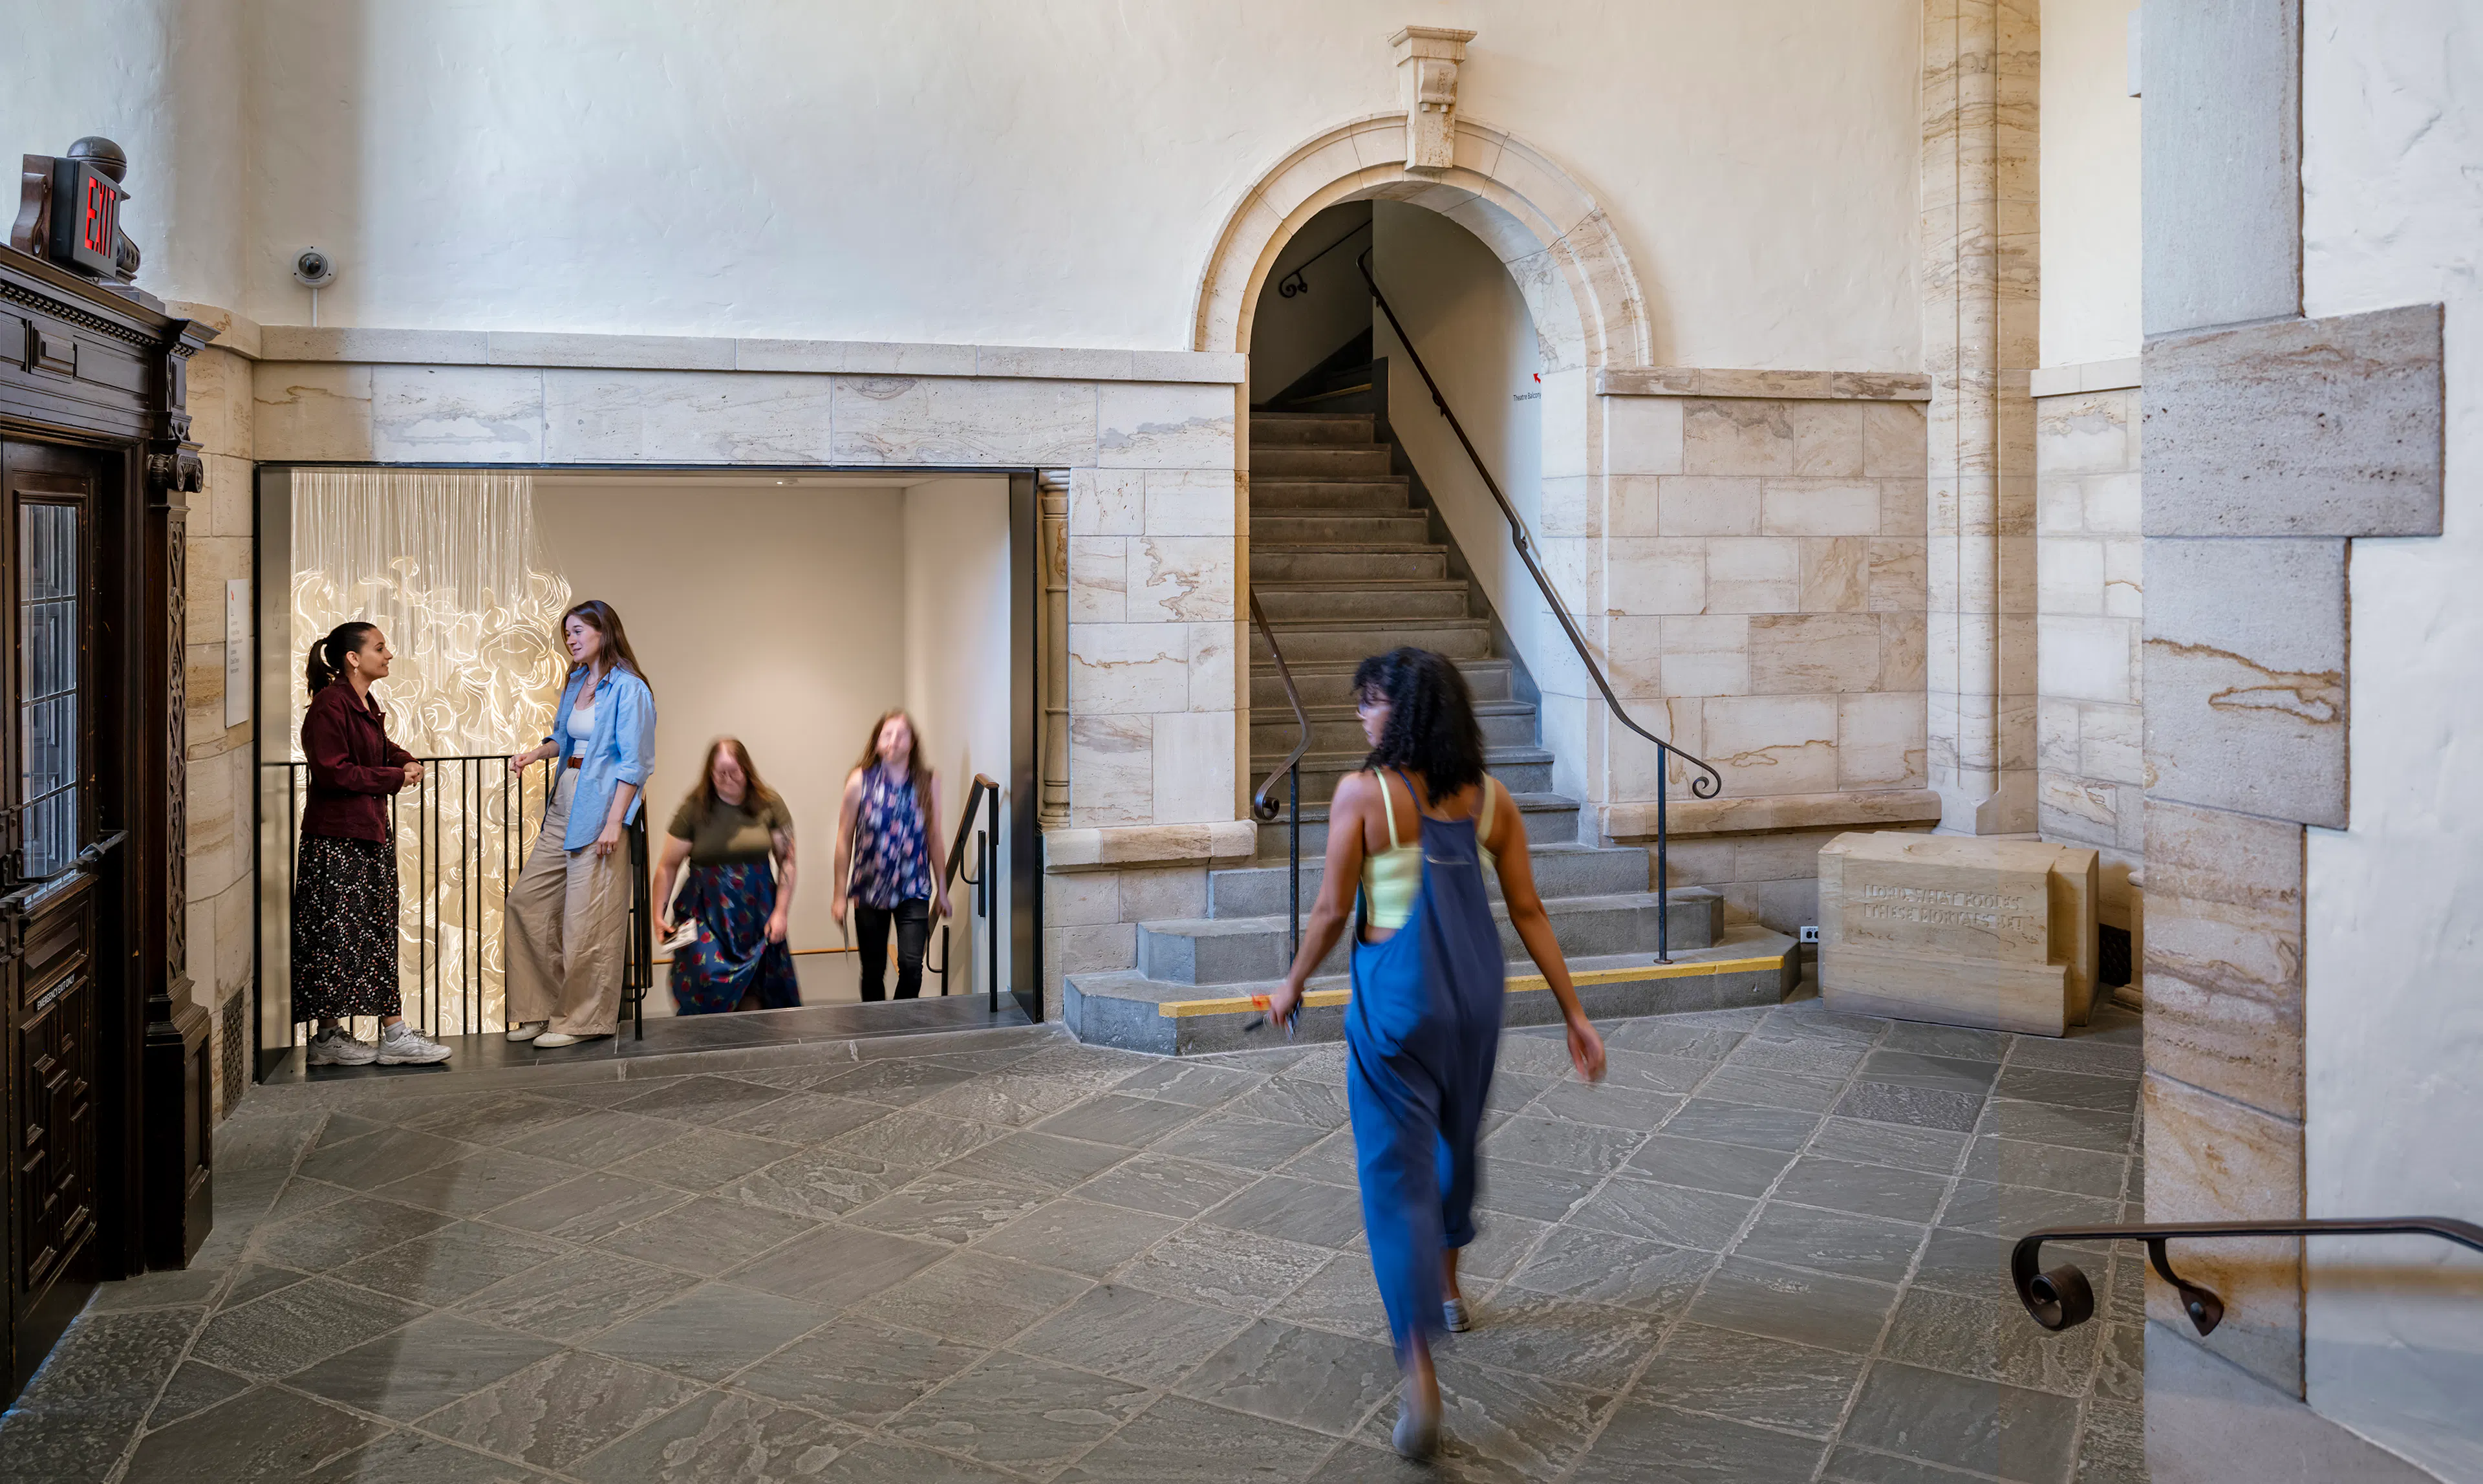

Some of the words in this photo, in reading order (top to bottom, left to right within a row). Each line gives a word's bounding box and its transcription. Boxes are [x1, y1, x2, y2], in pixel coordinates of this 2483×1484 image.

[85, 176, 116, 259] EXIT
[1910, 888, 1957, 905] WHAT
[1963, 892, 2023, 910] FOOLES
[1865, 904, 1913, 921] THESE
[1919, 908, 1990, 927] MORTALS
[38, 987, 58, 1010] EMERGENCY
[65, 973, 75, 987] ONLY
